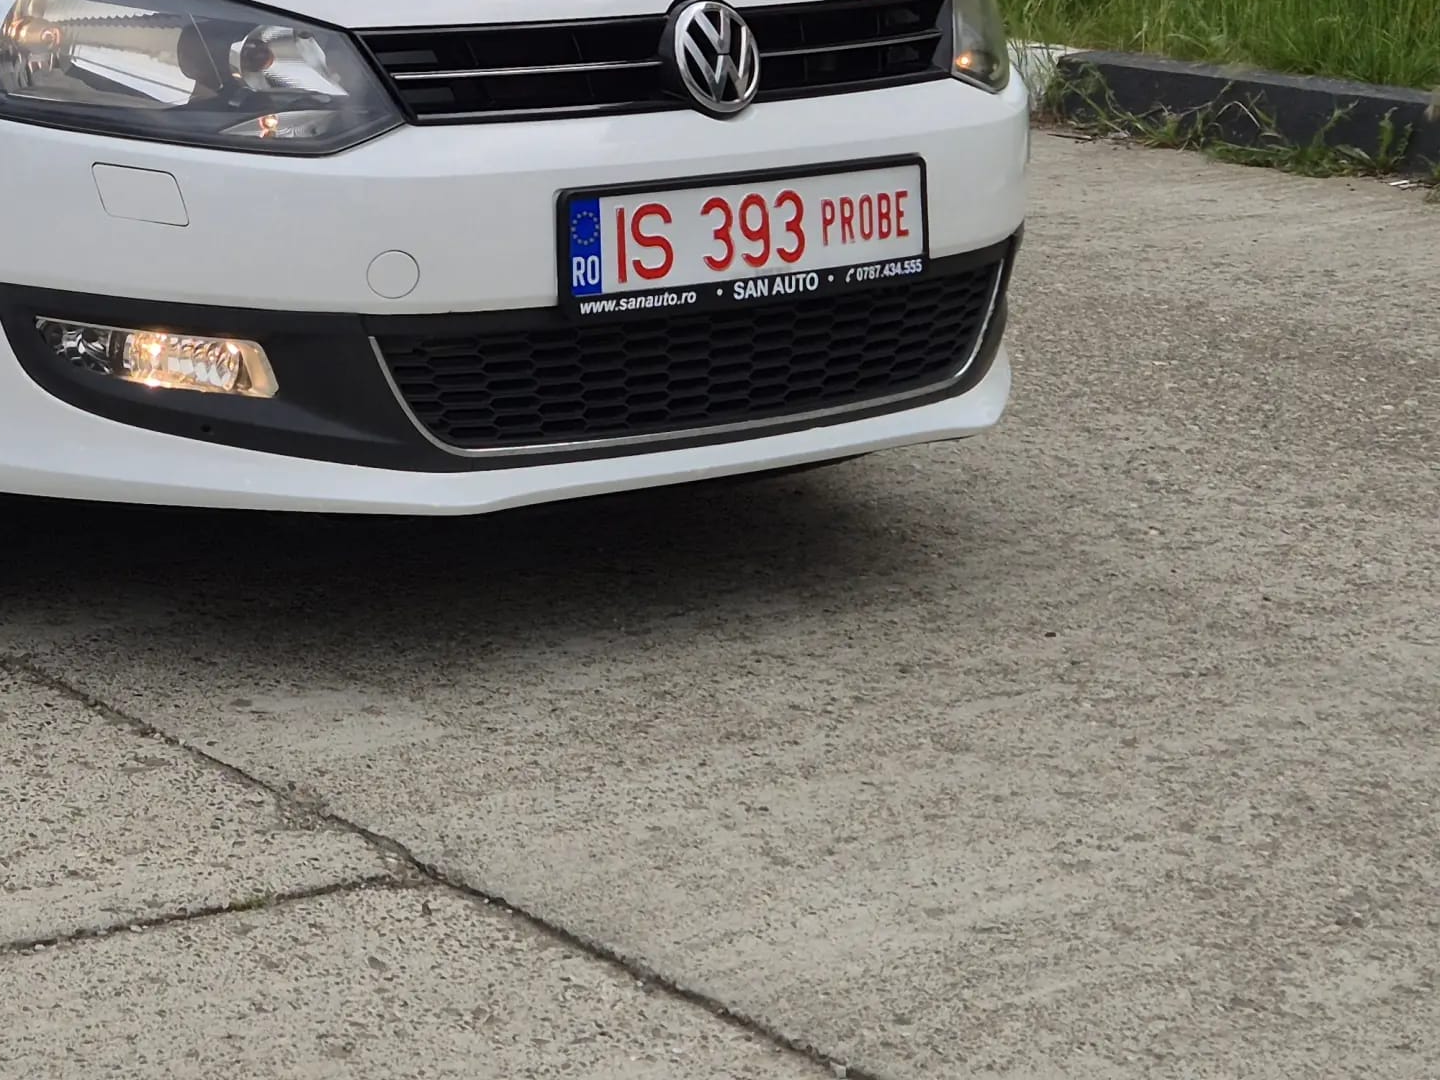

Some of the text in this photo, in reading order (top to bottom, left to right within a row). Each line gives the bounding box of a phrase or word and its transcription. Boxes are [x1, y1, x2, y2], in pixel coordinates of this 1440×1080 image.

[615, 190, 910, 284] IS 393 PROBE
[572, 255, 600, 288] RO
[856, 258, 923, 282] 0787.434.555
[733, 272, 819, 300] SAN AUTO
[579, 290, 697, 315] www.sanauto.ro
